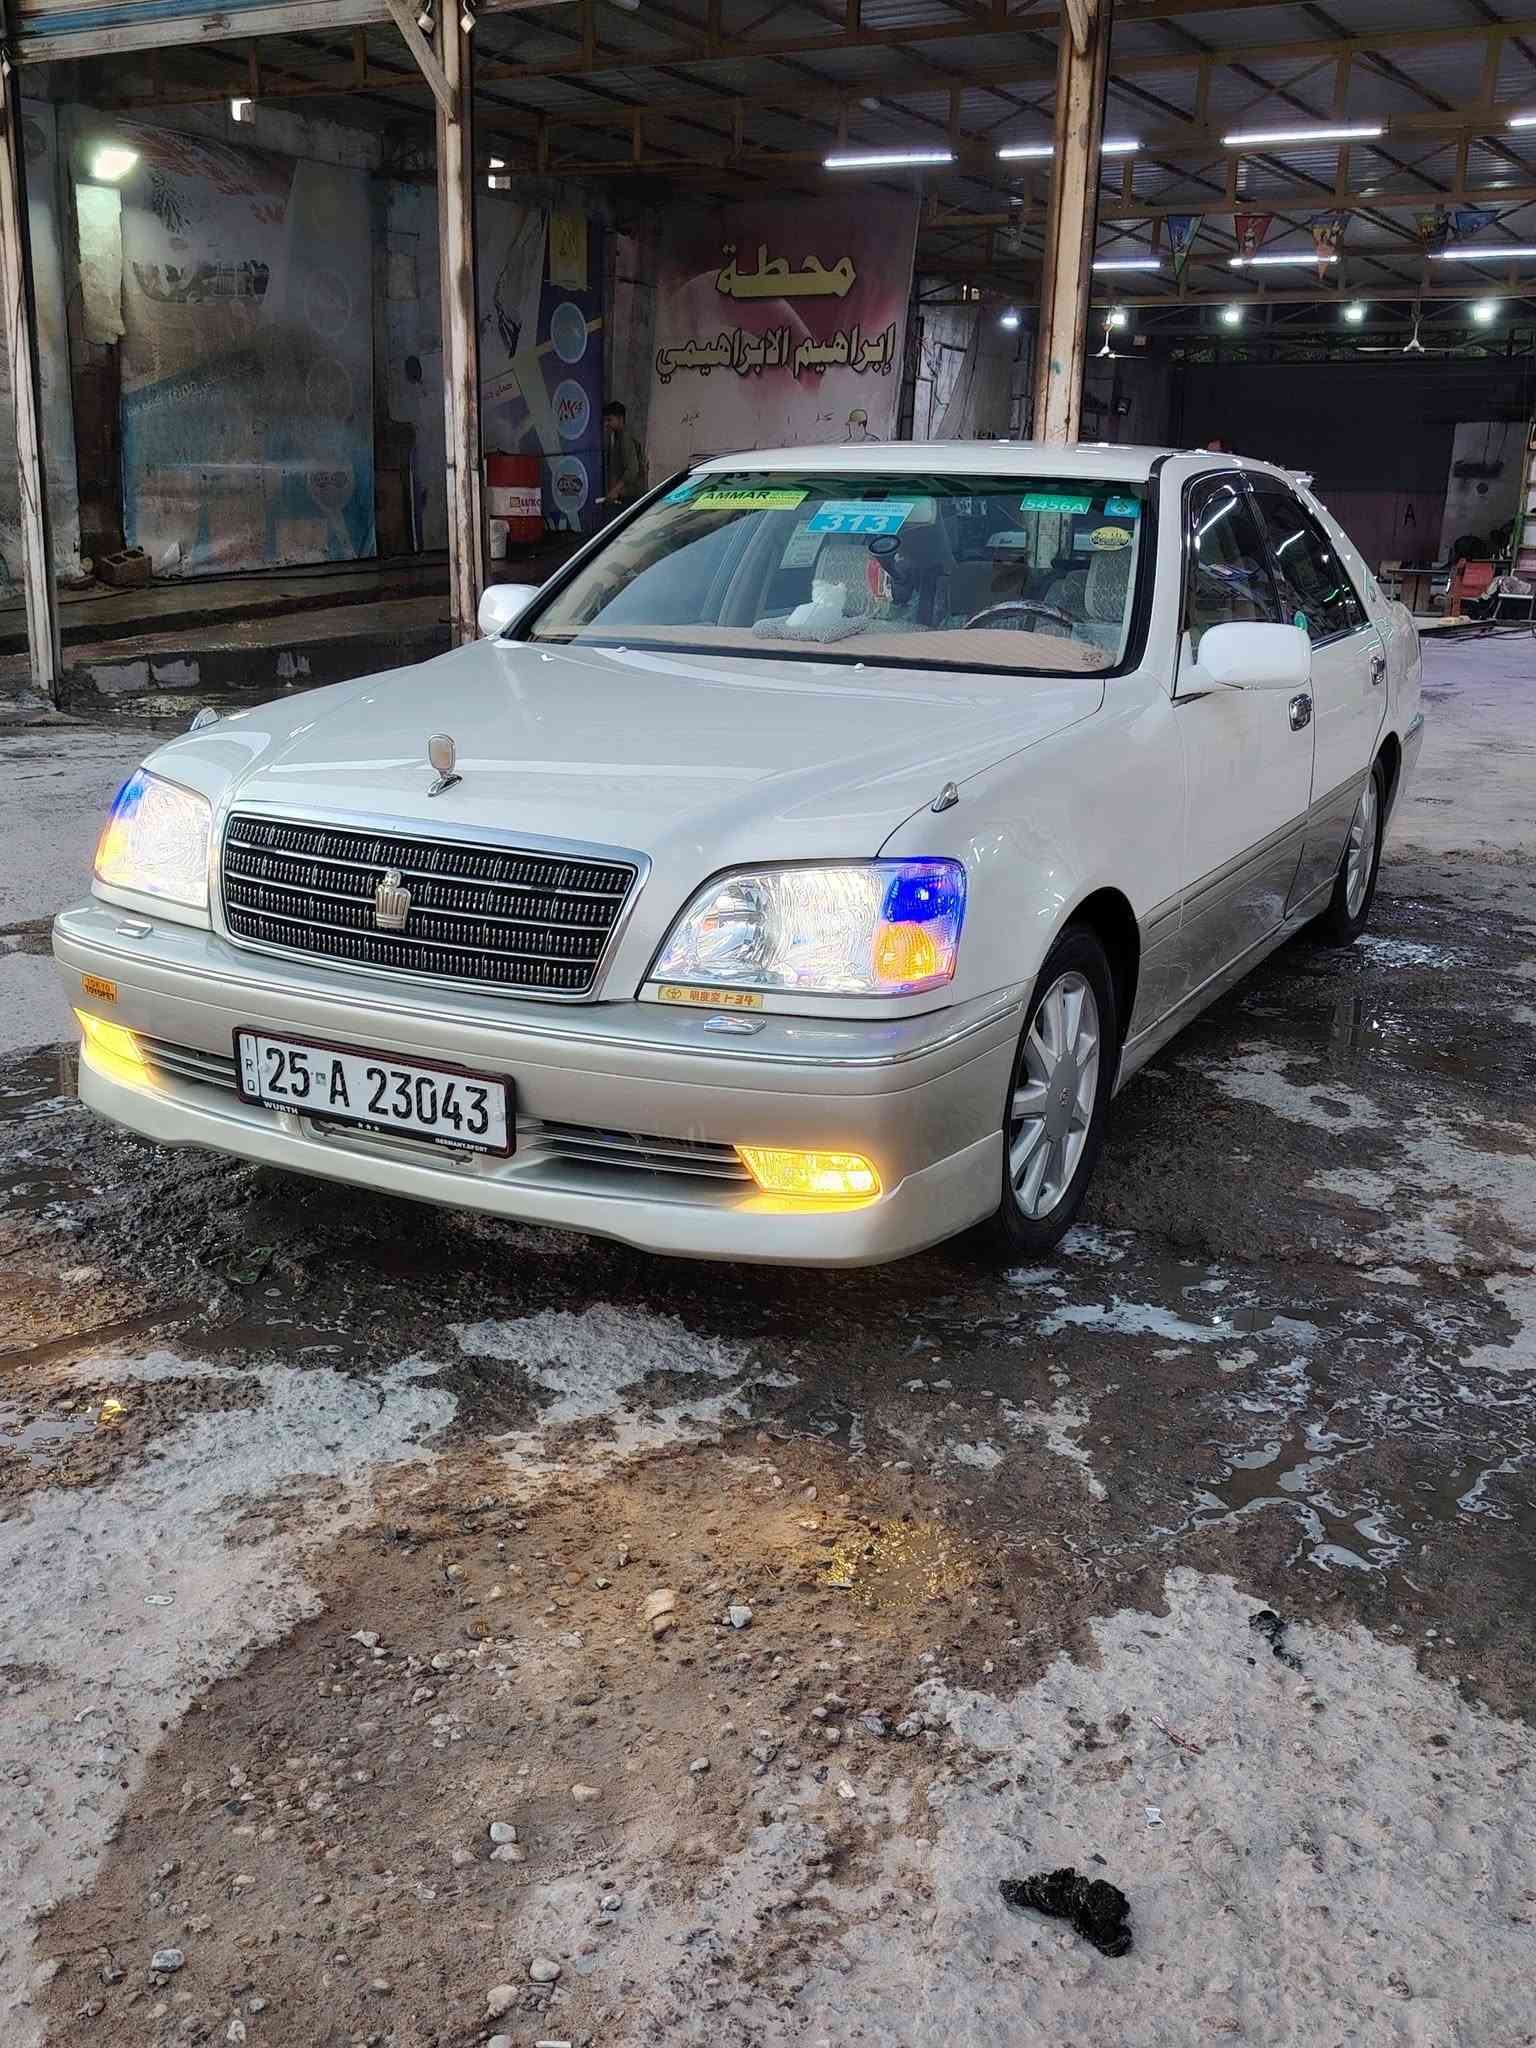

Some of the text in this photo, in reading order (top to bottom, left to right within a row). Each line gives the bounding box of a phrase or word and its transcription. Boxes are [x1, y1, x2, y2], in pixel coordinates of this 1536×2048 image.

[715, 243, 857, 298] محطة
[702, 491, 770, 500] AMMAR
[1025, 500, 1083, 512] 5456A
[821, 514, 889, 532] 313
[265, 1047, 489, 1135] 25 A 23043
[263, 1101, 299, 1115] WURTH
